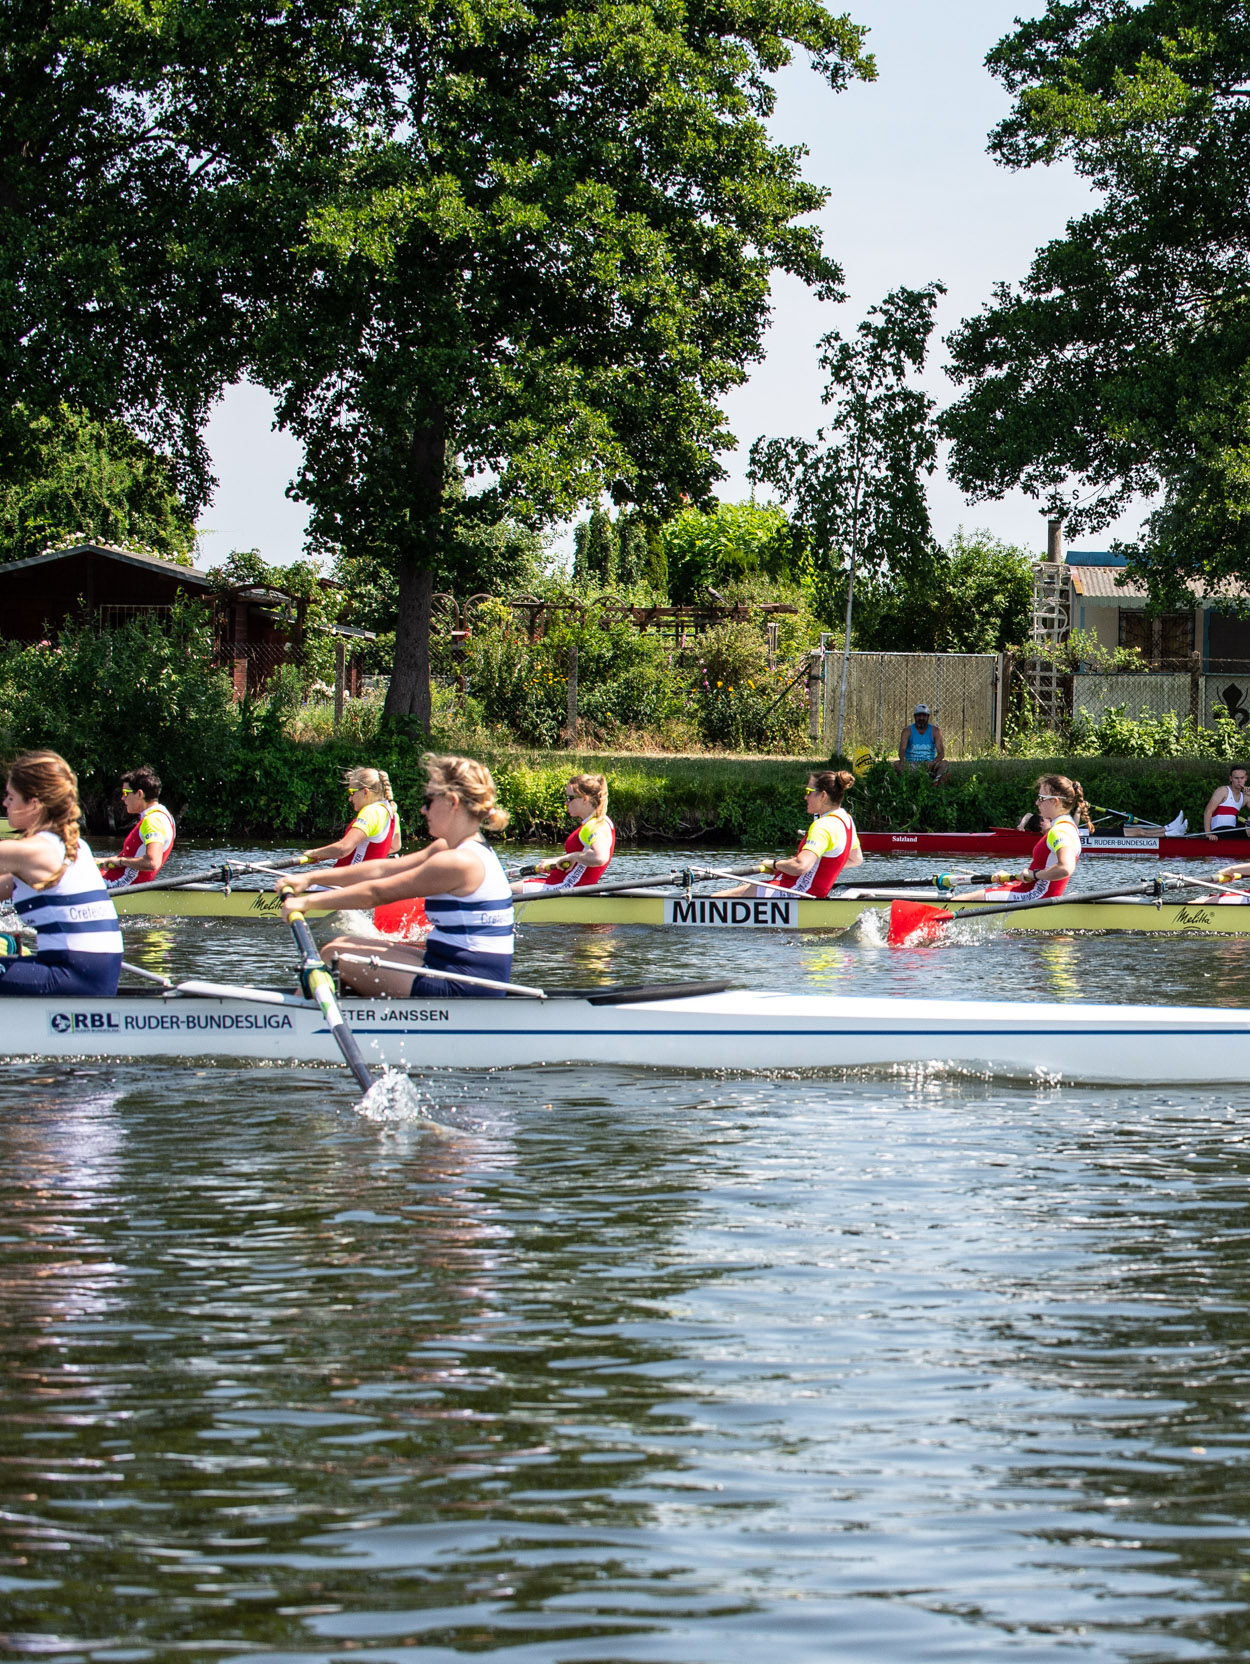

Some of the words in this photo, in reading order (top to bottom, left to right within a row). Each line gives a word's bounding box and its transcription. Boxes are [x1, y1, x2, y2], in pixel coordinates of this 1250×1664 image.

[1094, 839, 1158, 847] RUDER-BUNDESLIGA
[249, 894, 285, 911] Melitt
[672, 902, 790, 925] MINDEN
[74, 1013, 119, 1029] RBL
[124, 1014, 293, 1030] RUDER-BUNDESLIGA
[380, 1009, 449, 1021] JANSSEN
